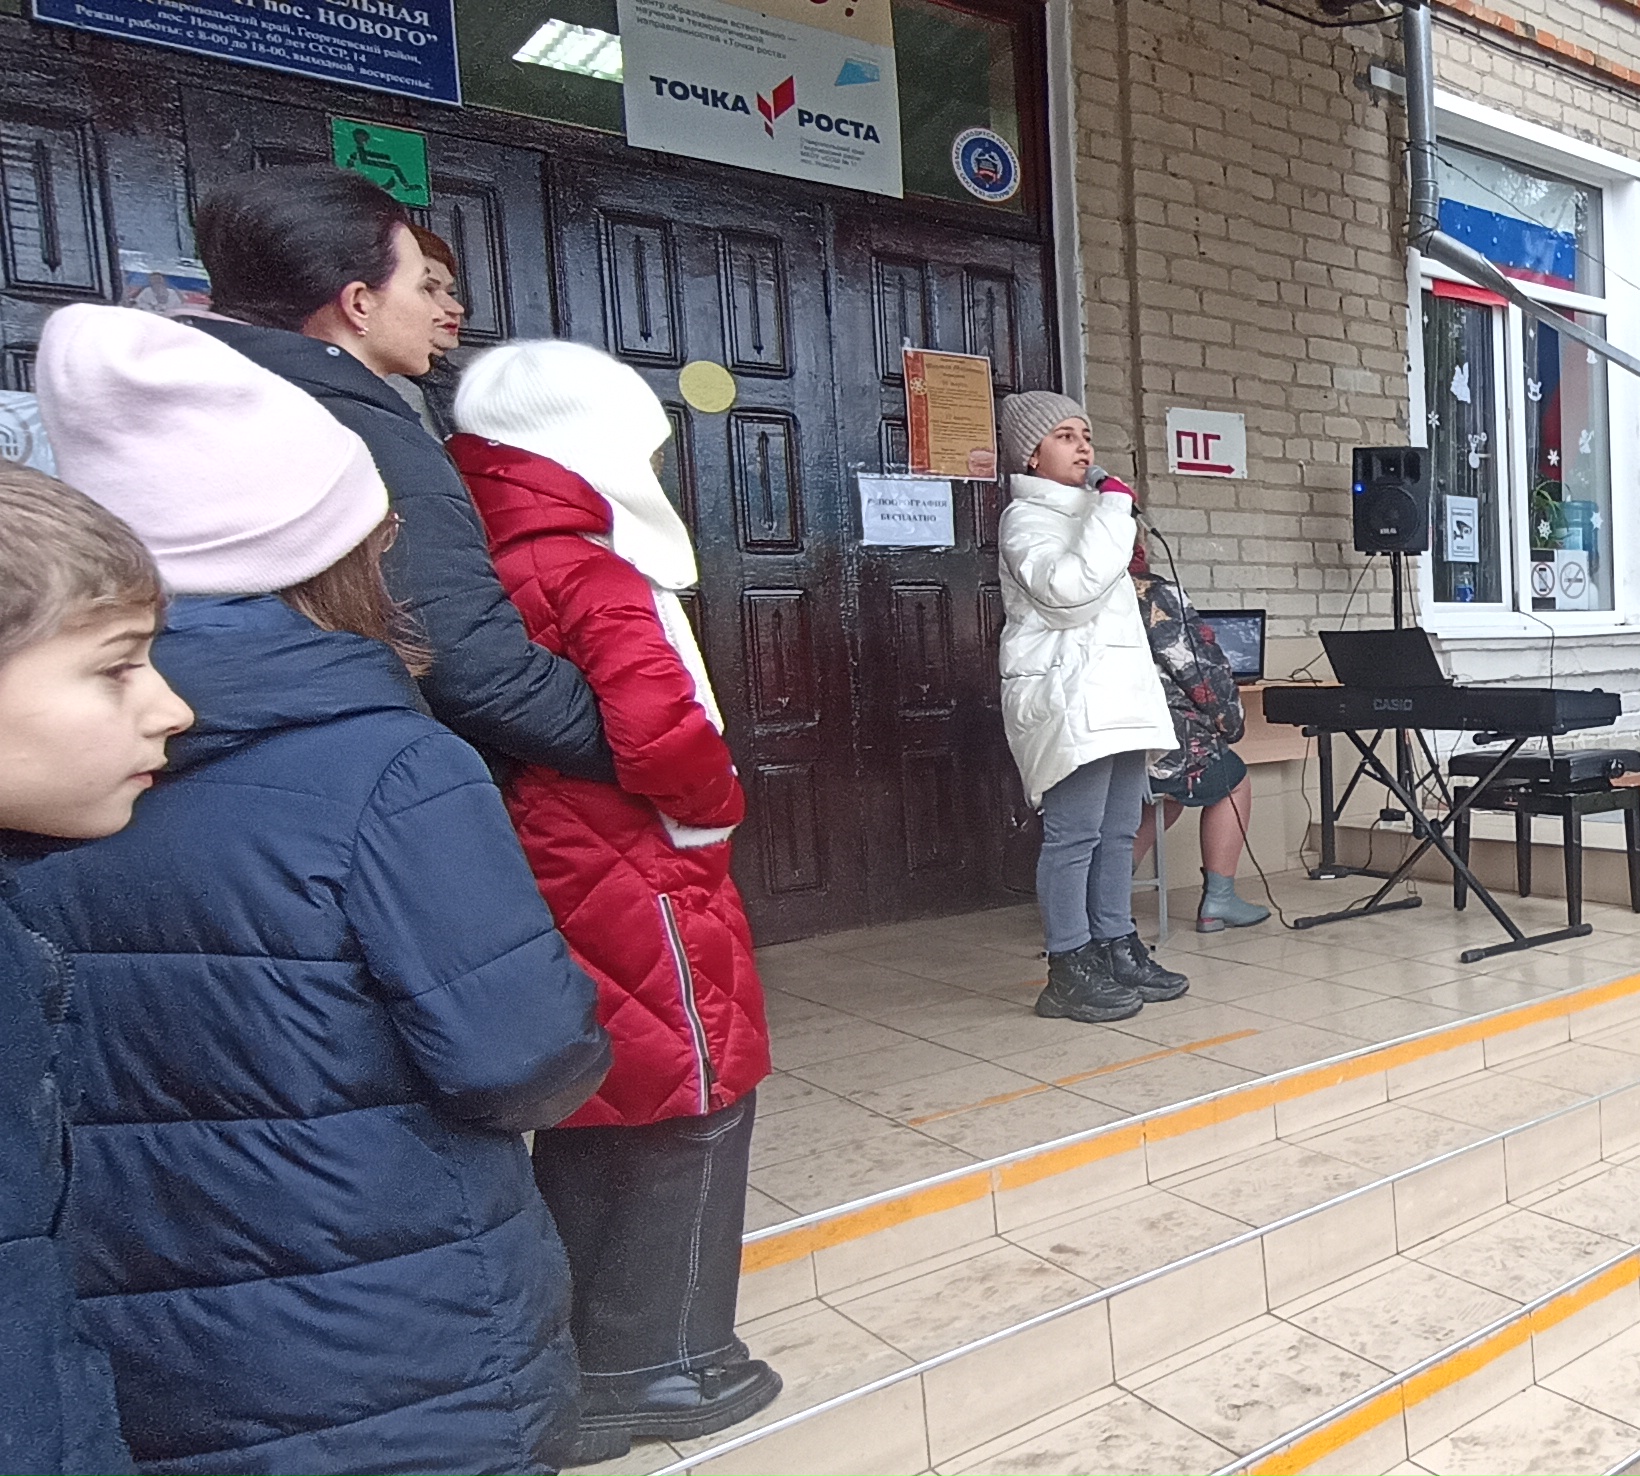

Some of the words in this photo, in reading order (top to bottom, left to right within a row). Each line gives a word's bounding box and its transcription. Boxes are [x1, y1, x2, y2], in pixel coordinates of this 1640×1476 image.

[145, 0, 258, 27] тавропольский
[264, 0, 311, 20] пос.
[634, 0, 665, 9] ентр
[668, 4, 728, 25] образования
[75, 4, 125, 24] Режим
[186, 29, 195, 39] с
[197, 30, 229, 46] 8-00
[229, 41, 247, 52] до
[292, 52, 355, 73] выходной
[636, 6, 676, 20] научной
[687, 17, 765, 44] технологической
[636, 16, 721, 43] направленностей
[265, 33, 282, 44] 60
[284, 38, 307, 50] лет
[353, 51, 367, 63] 14
[649, 74, 751, 116] ТОЧКА
[797, 108, 881, 144] РОСТА
[1176, 430, 1221, 461] ПГ
[880, 513, 937, 522] БЕСПЛАТНО
[1373, 698, 1413, 711] CASIO
